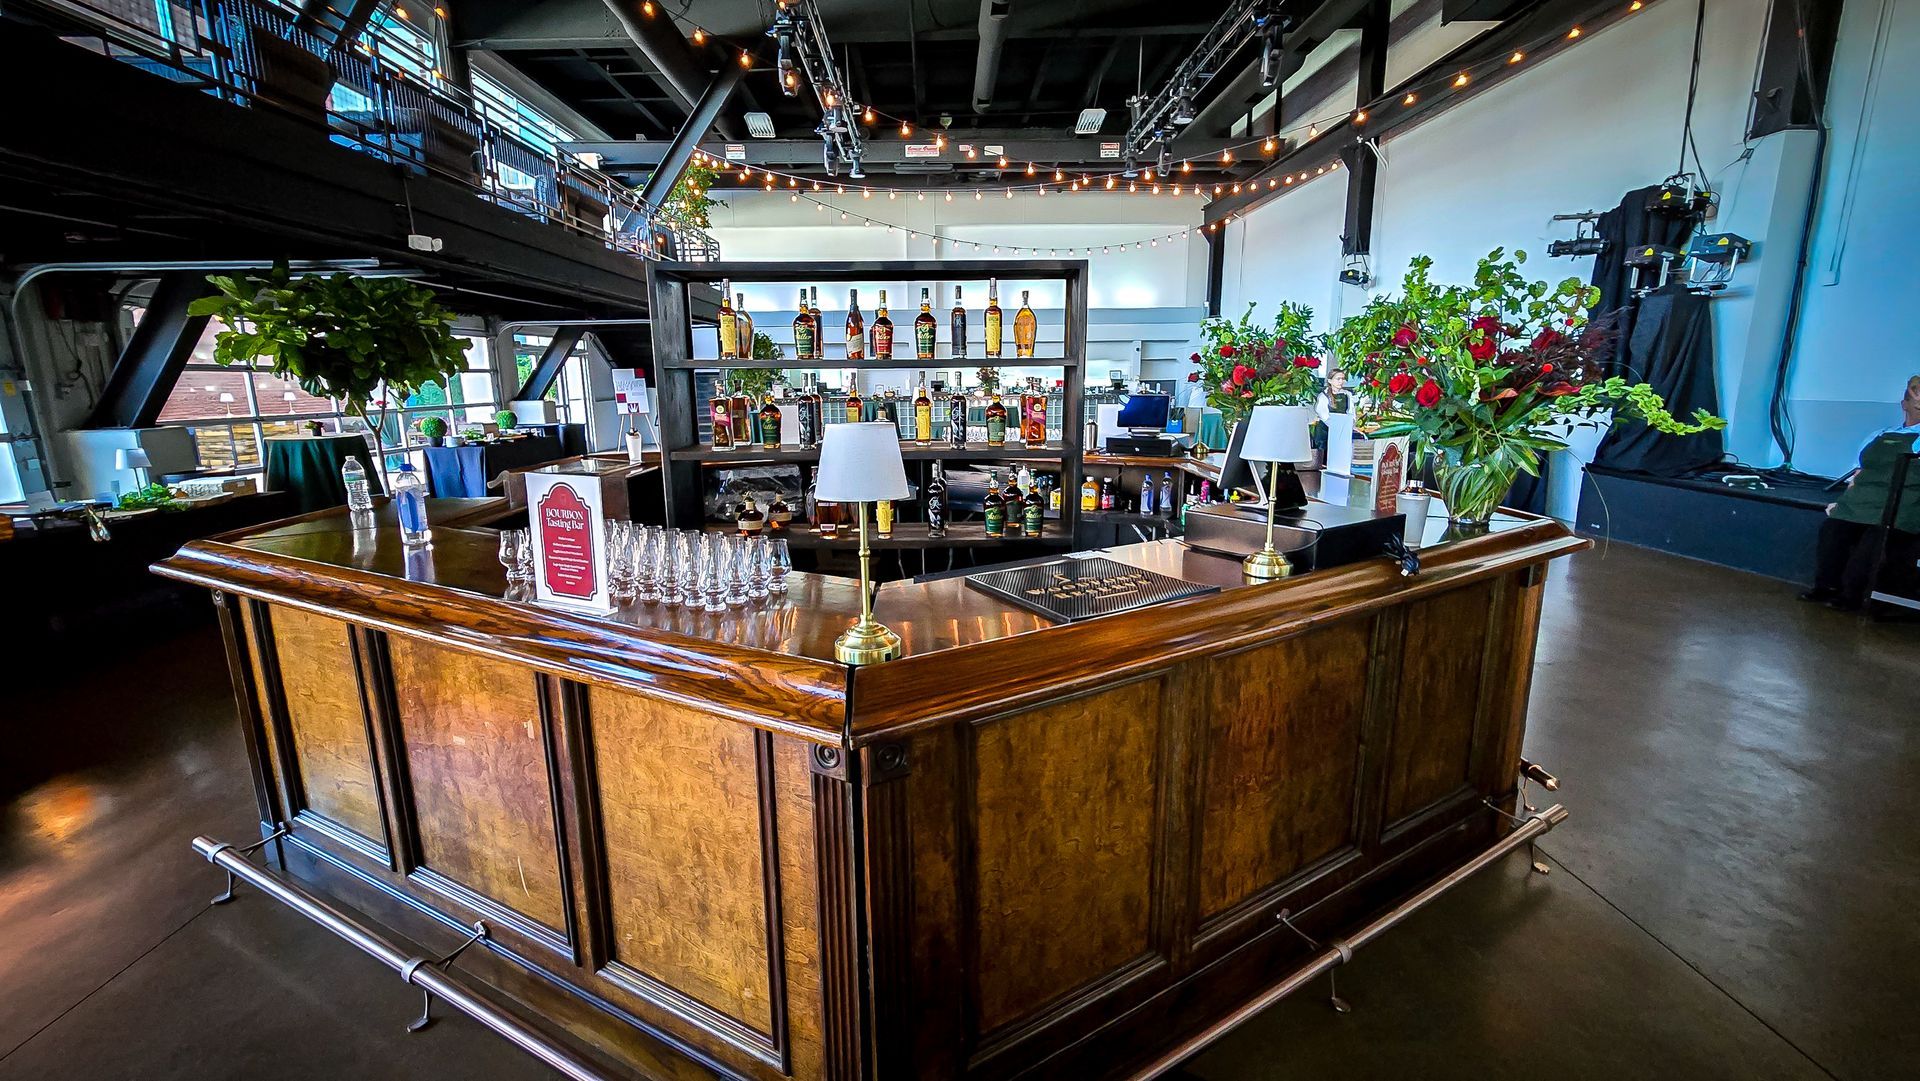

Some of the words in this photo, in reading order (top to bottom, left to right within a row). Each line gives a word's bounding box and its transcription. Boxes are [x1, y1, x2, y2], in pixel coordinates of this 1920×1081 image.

[546, 508, 583, 520] BOURBON
[546, 518, 571, 531] Tasting
[572, 520, 584, 530] Bar
